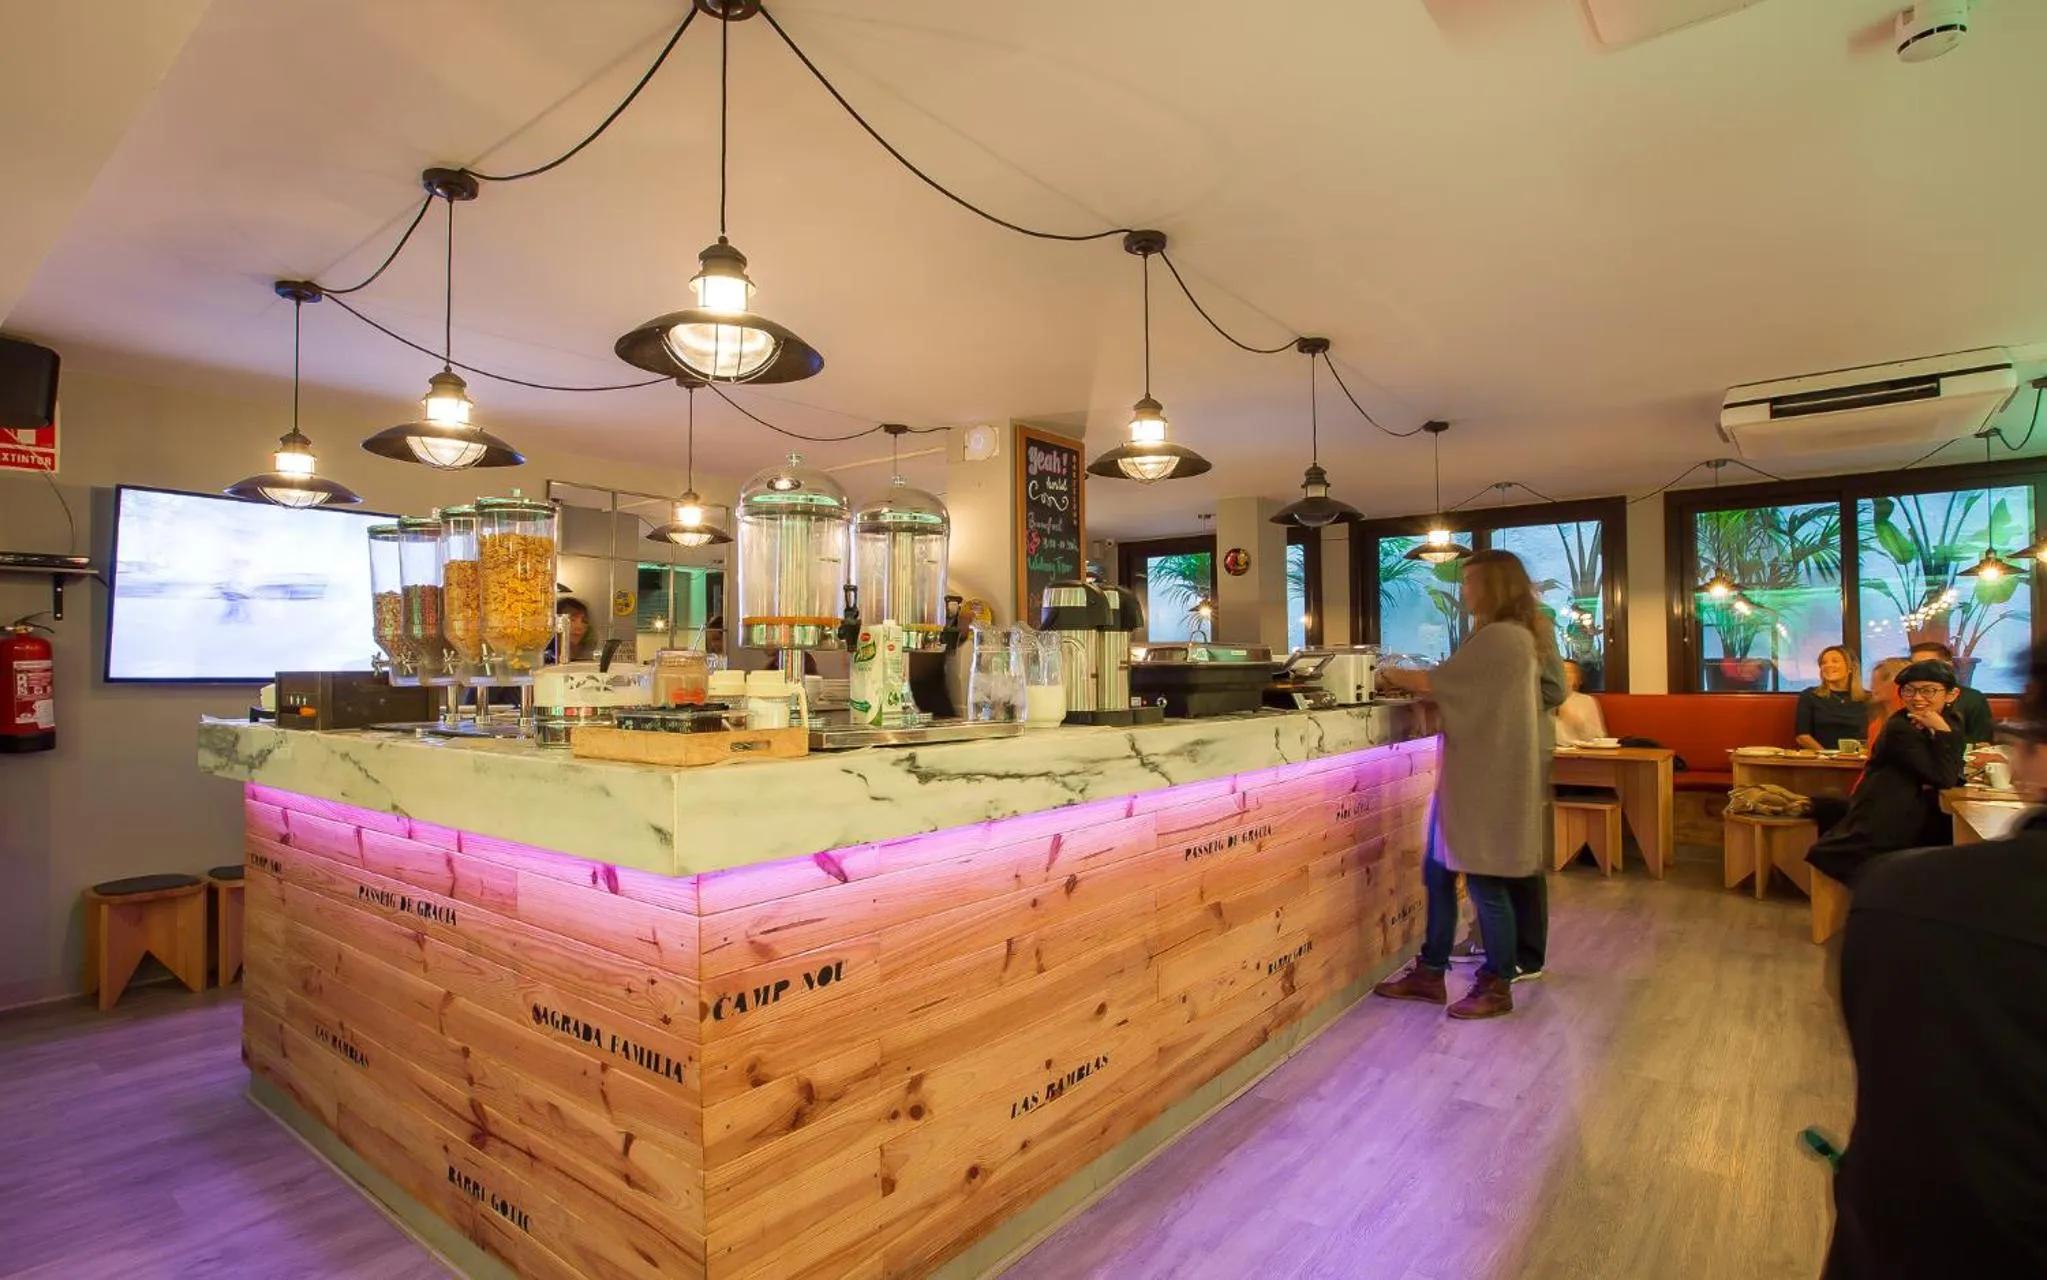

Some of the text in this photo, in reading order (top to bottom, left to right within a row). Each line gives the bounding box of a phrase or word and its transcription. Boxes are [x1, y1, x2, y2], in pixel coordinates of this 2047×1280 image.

[1184, 842, 1224, 861] PASSEIG
[357, 885, 457, 926] PASSEIG DE GRACIA
[713, 959, 849, 1021] CAMP NOU
[531, 1002, 684, 1084] SAGRADA FAMILIA
[1010, 1052, 1109, 1120] LAS RAMBLAS
[447, 1164, 533, 1234] BARRI GOTIC
